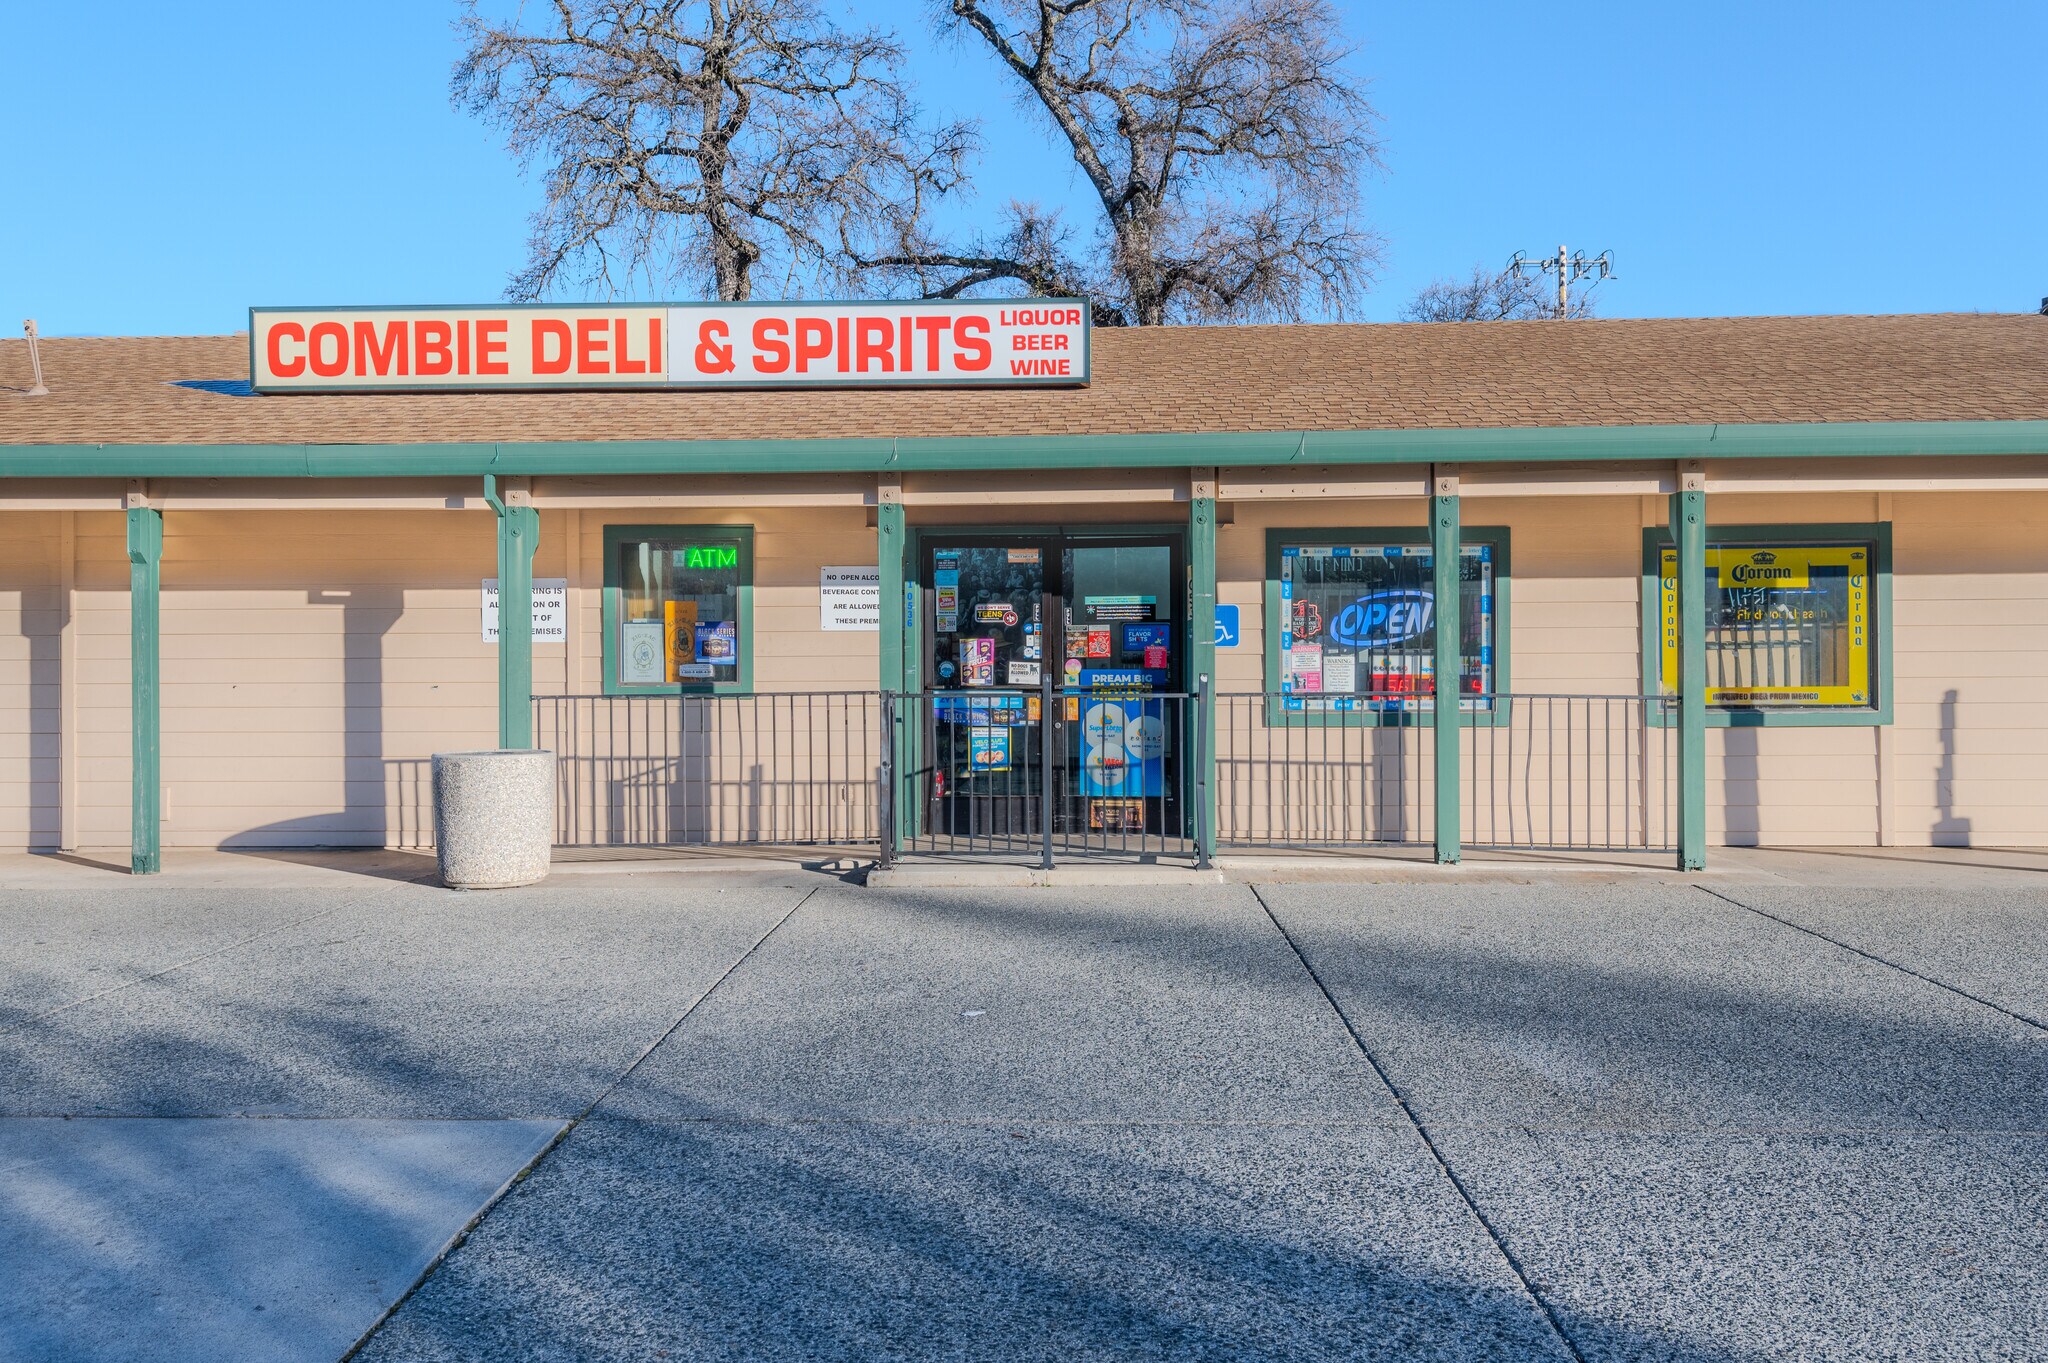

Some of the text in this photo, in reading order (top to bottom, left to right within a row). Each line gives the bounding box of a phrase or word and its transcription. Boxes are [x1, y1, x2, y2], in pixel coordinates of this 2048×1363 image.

[1001, 310, 1080, 326] LIQUOR
[268, 316, 991, 377] COMBIE DELI & SPIRITS
[1013, 334, 1068, 351] BEER
[1011, 360, 1070, 376] WINE
[690, 549, 737, 567] ATM
[1732, 564, 1792, 584] Corona
[1340, 603, 1433, 635] OPEN
[1663, 577, 1677, 648] Corona
[1850, 574, 1864, 646] Corona
[1092, 674, 1153, 682] DREAM BIG
[1791, 692, 1819, 700] MEXICO
